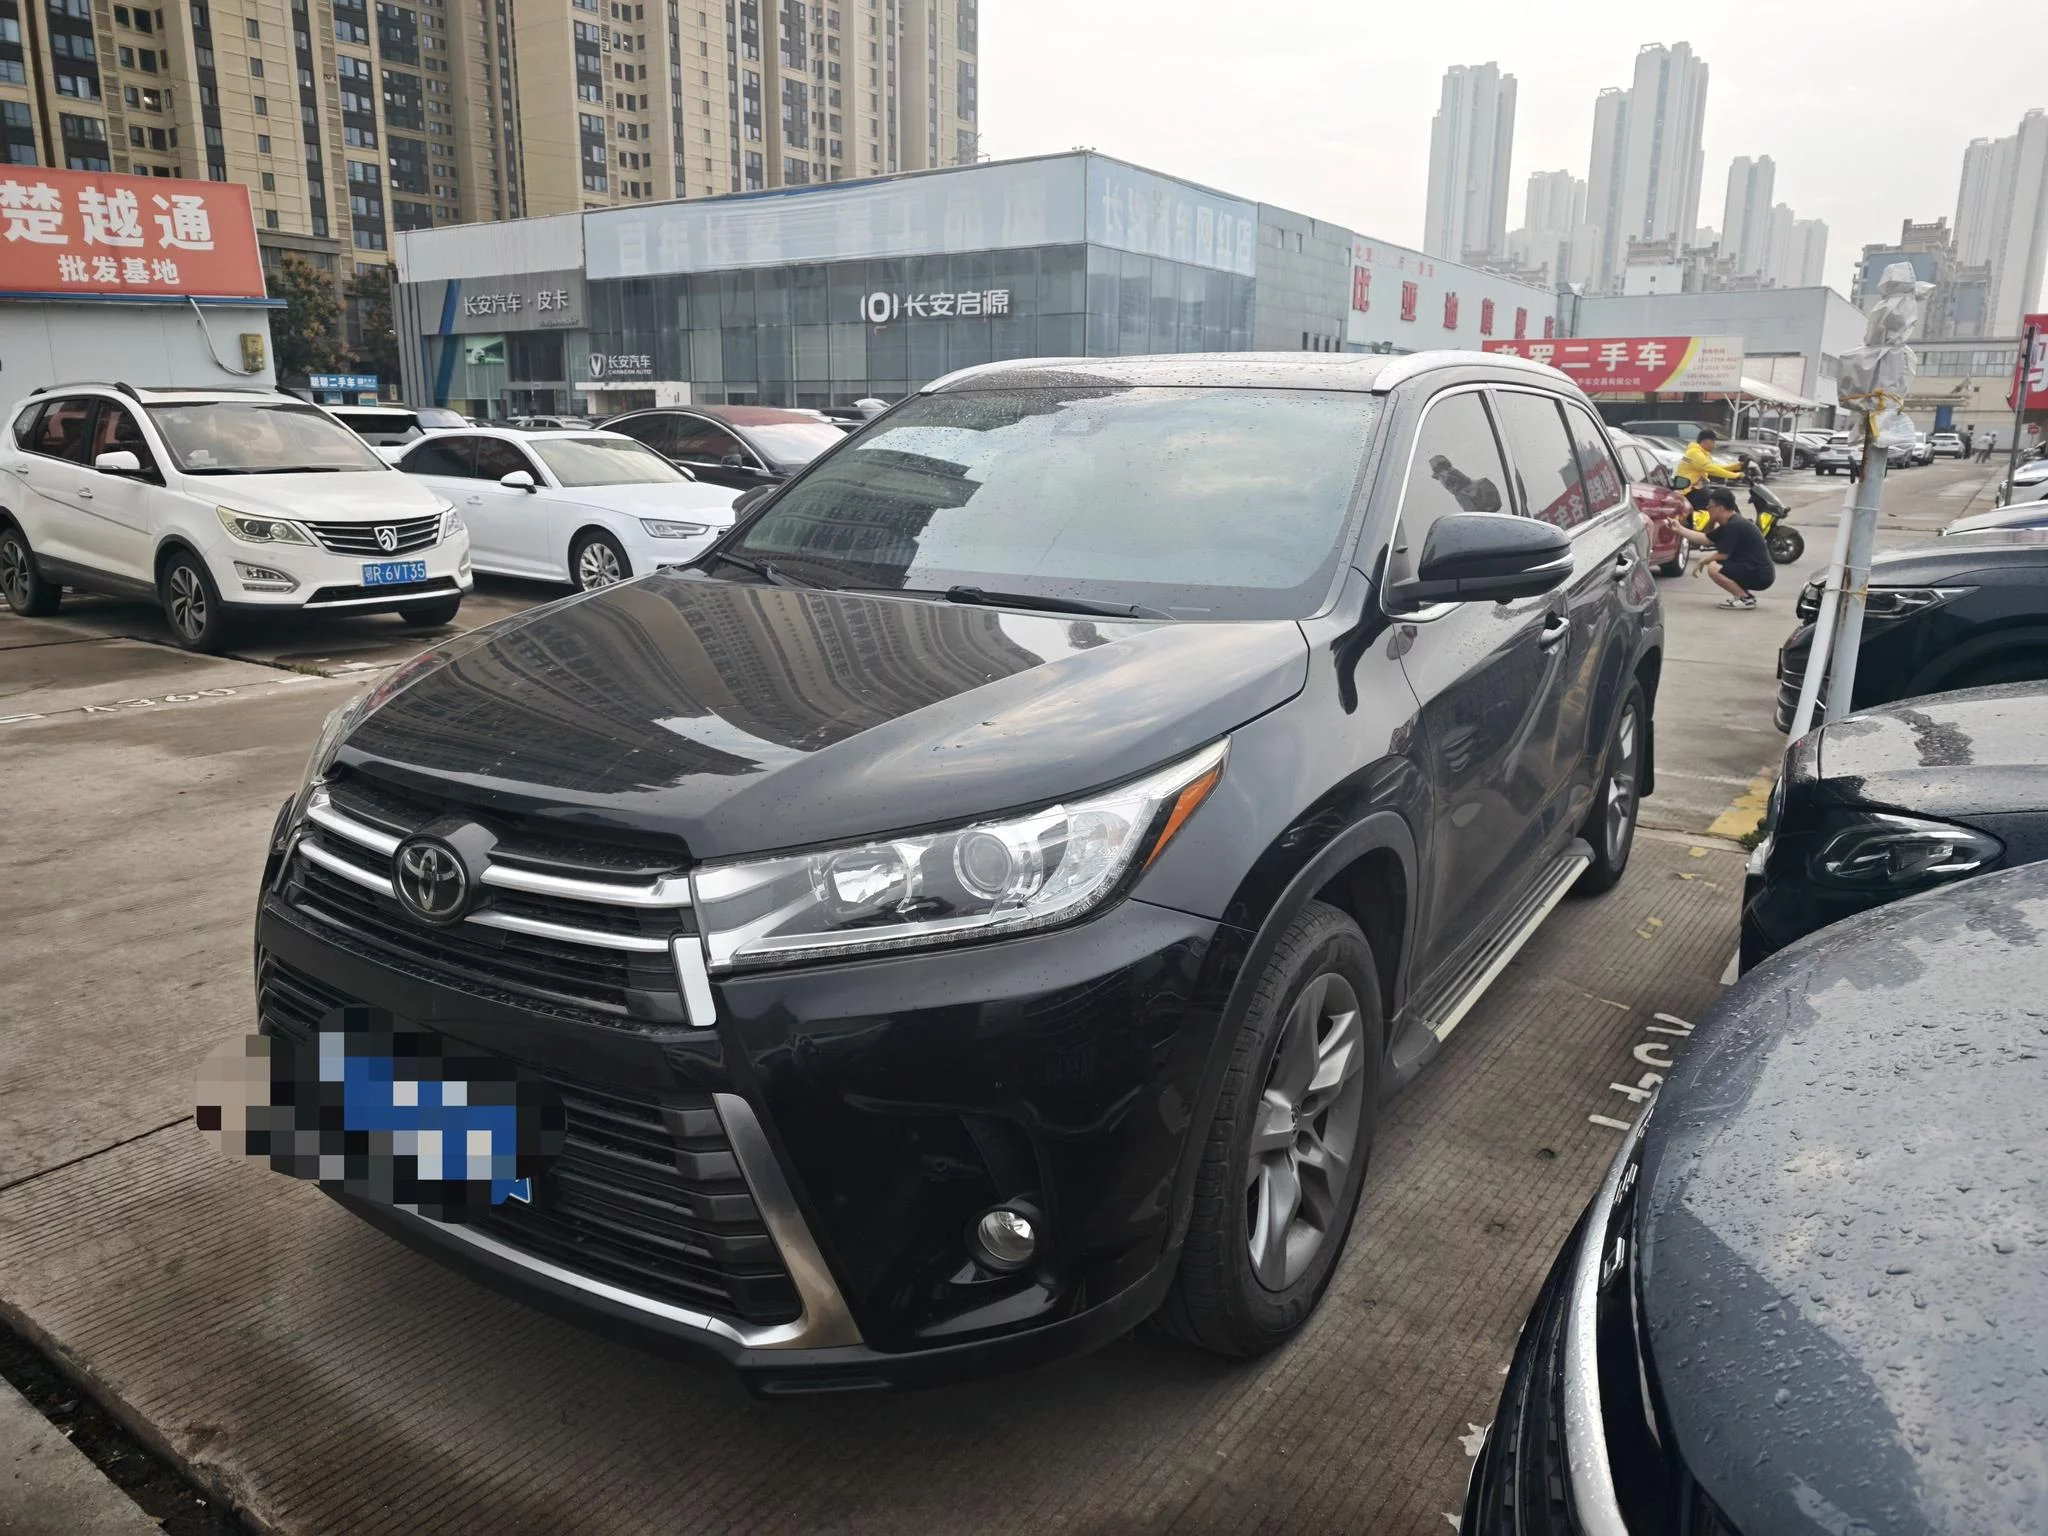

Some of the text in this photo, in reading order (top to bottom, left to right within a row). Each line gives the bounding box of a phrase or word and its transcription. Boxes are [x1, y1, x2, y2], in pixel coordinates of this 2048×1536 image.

[0, 180, 214, 251] 楚越通
[58, 254, 180, 285] 批发基地
[904, 288, 1010, 317] 长安启源
[608, 355, 651, 368] 长安汽车
